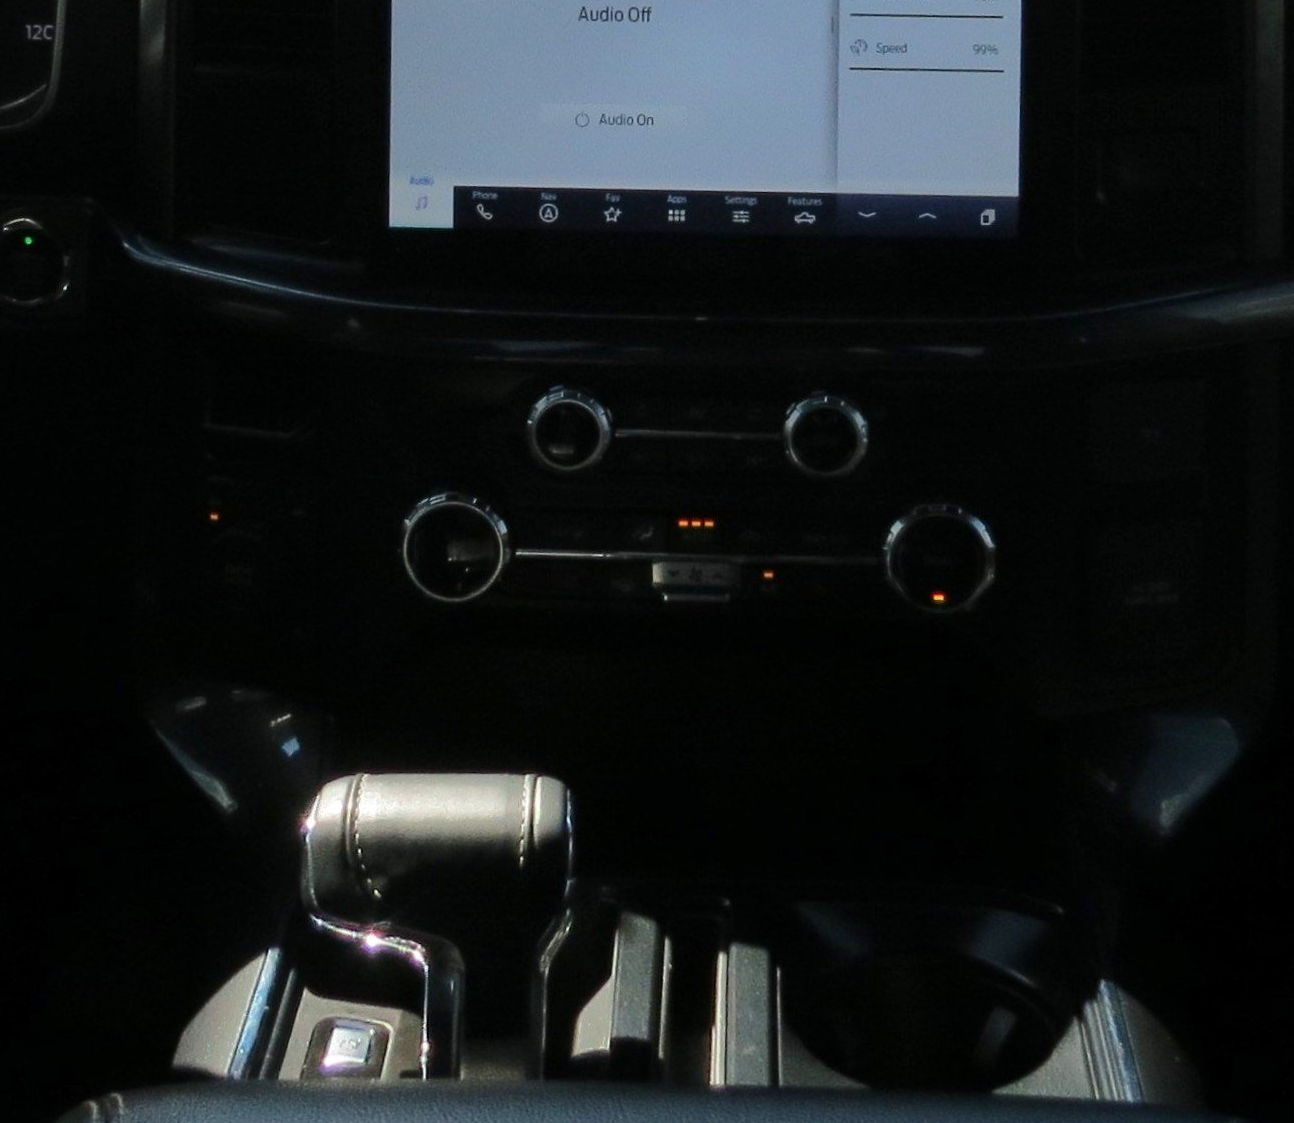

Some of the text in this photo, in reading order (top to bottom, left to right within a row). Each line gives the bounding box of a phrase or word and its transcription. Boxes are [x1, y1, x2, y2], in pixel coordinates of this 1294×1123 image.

[578, 6, 652, 23] Audio Off
[875, 41, 908, 56] Speed
[599, 112, 655, 127] Audio On
[409, 175, 435, 186] Audio
[472, 190, 498, 200] Phone
[666, 194, 687, 205] Apps
[723, 195, 758, 207] Settings
[787, 196, 823, 206] Features
